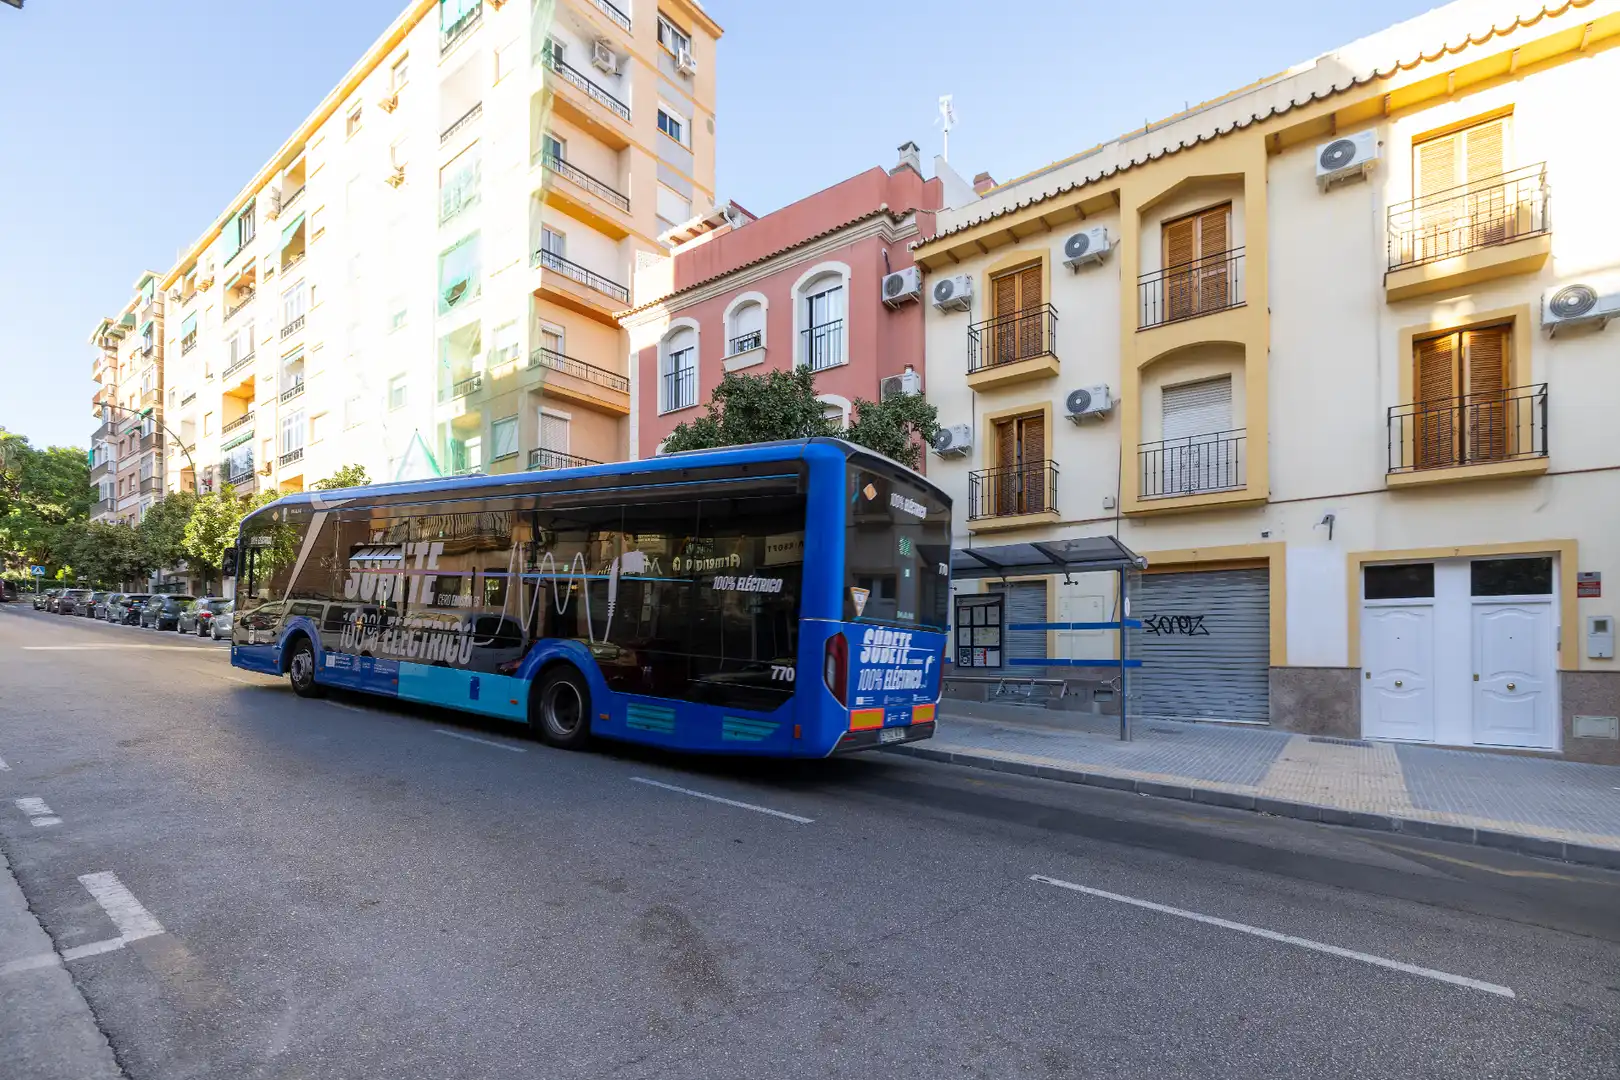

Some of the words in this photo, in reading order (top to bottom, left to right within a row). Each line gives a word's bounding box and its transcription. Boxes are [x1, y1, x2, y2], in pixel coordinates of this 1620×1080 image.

[939, 562, 949, 577] 770
[712, 575, 736, 592] 100%
[736, 574, 784, 594] ELÉCTRICO
[860, 626, 912, 664] SÚBETE
[771, 665, 796, 682] 770
[857, 668, 884, 691] 100%
[883, 665, 923, 690] ELÉCTRICO
